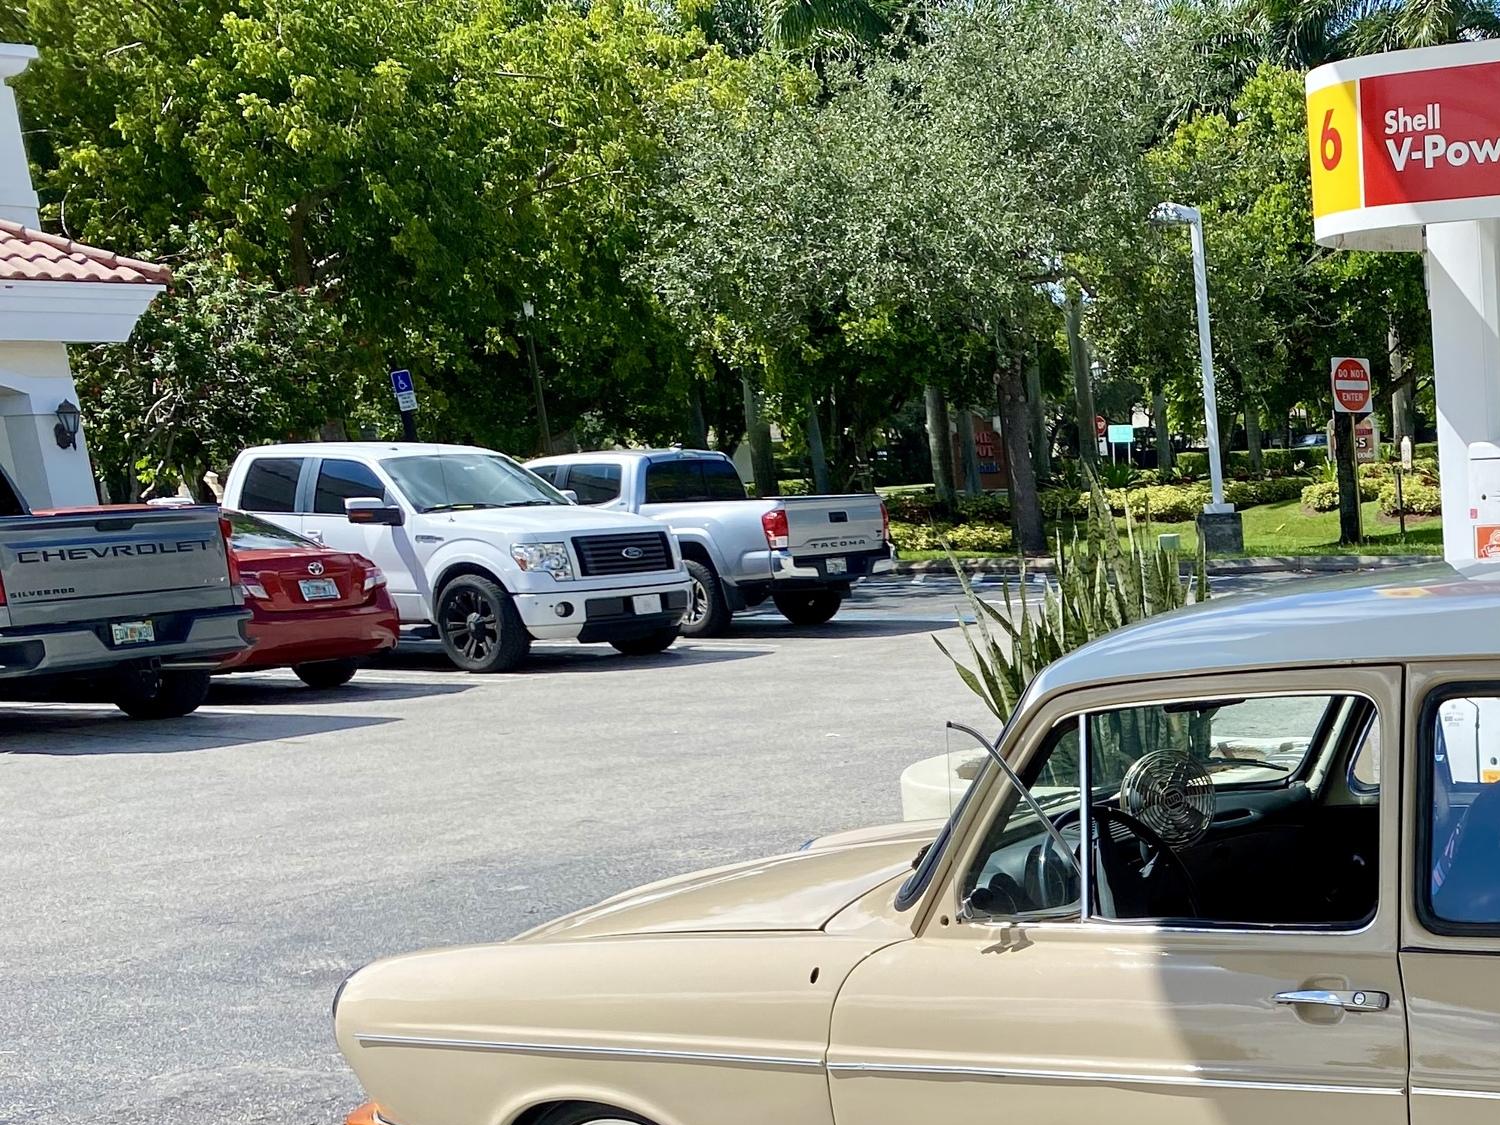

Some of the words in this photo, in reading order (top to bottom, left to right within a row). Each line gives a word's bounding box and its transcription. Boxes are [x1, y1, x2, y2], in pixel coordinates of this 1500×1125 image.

[1384, 103, 1440, 135] Shell
[1320, 108, 1343, 171] 6
[1338, 368, 1348, 378] DO
[1350, 369, 1364, 378] NOT
[1342, 392, 1364, 402] ENTER
[811, 540, 866, 549] TACOMA
[17, 539, 210, 564] CHEVROLET
[9, 587, 76, 599] SILVERADO
